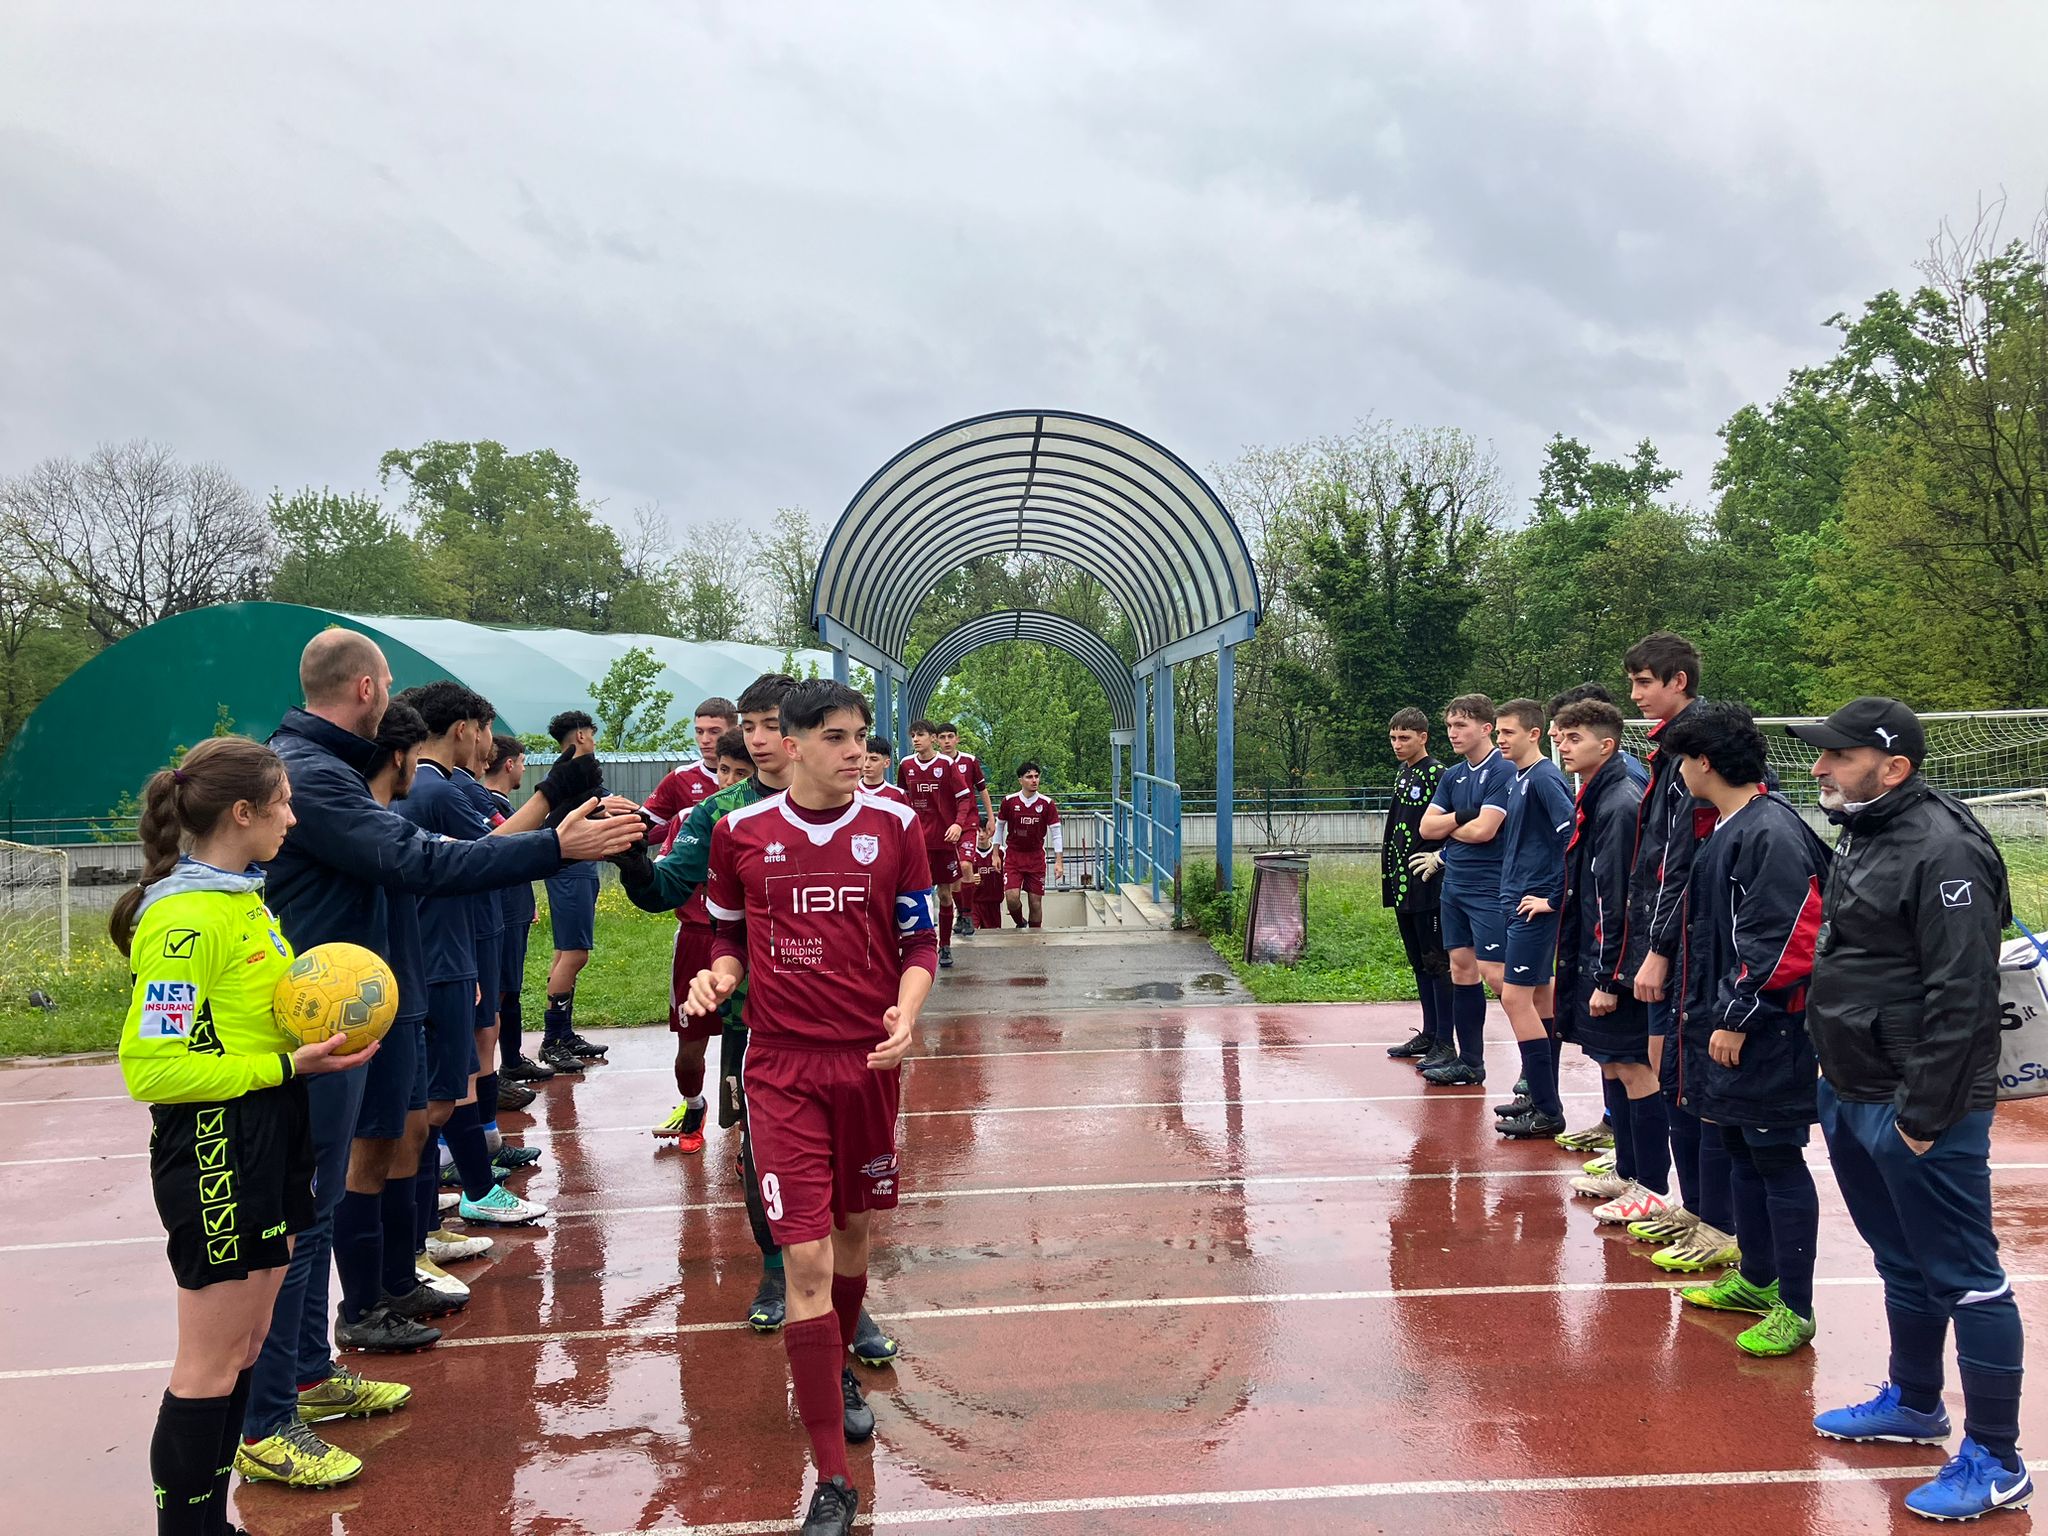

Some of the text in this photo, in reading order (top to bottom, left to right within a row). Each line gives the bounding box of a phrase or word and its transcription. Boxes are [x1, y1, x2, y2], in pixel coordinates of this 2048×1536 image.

[763, 854, 787, 863] errea
[792, 886, 865, 914] IBF
[895, 895, 920, 930] C
[780, 937, 823, 946] ITALIAN
[780, 946, 823, 956] BUILDING
[781, 956, 823, 966] FACTORY
[146, 983, 196, 1002] NET
[292, 991, 307, 1018] errea
[761, 1172, 784, 1221] 9
